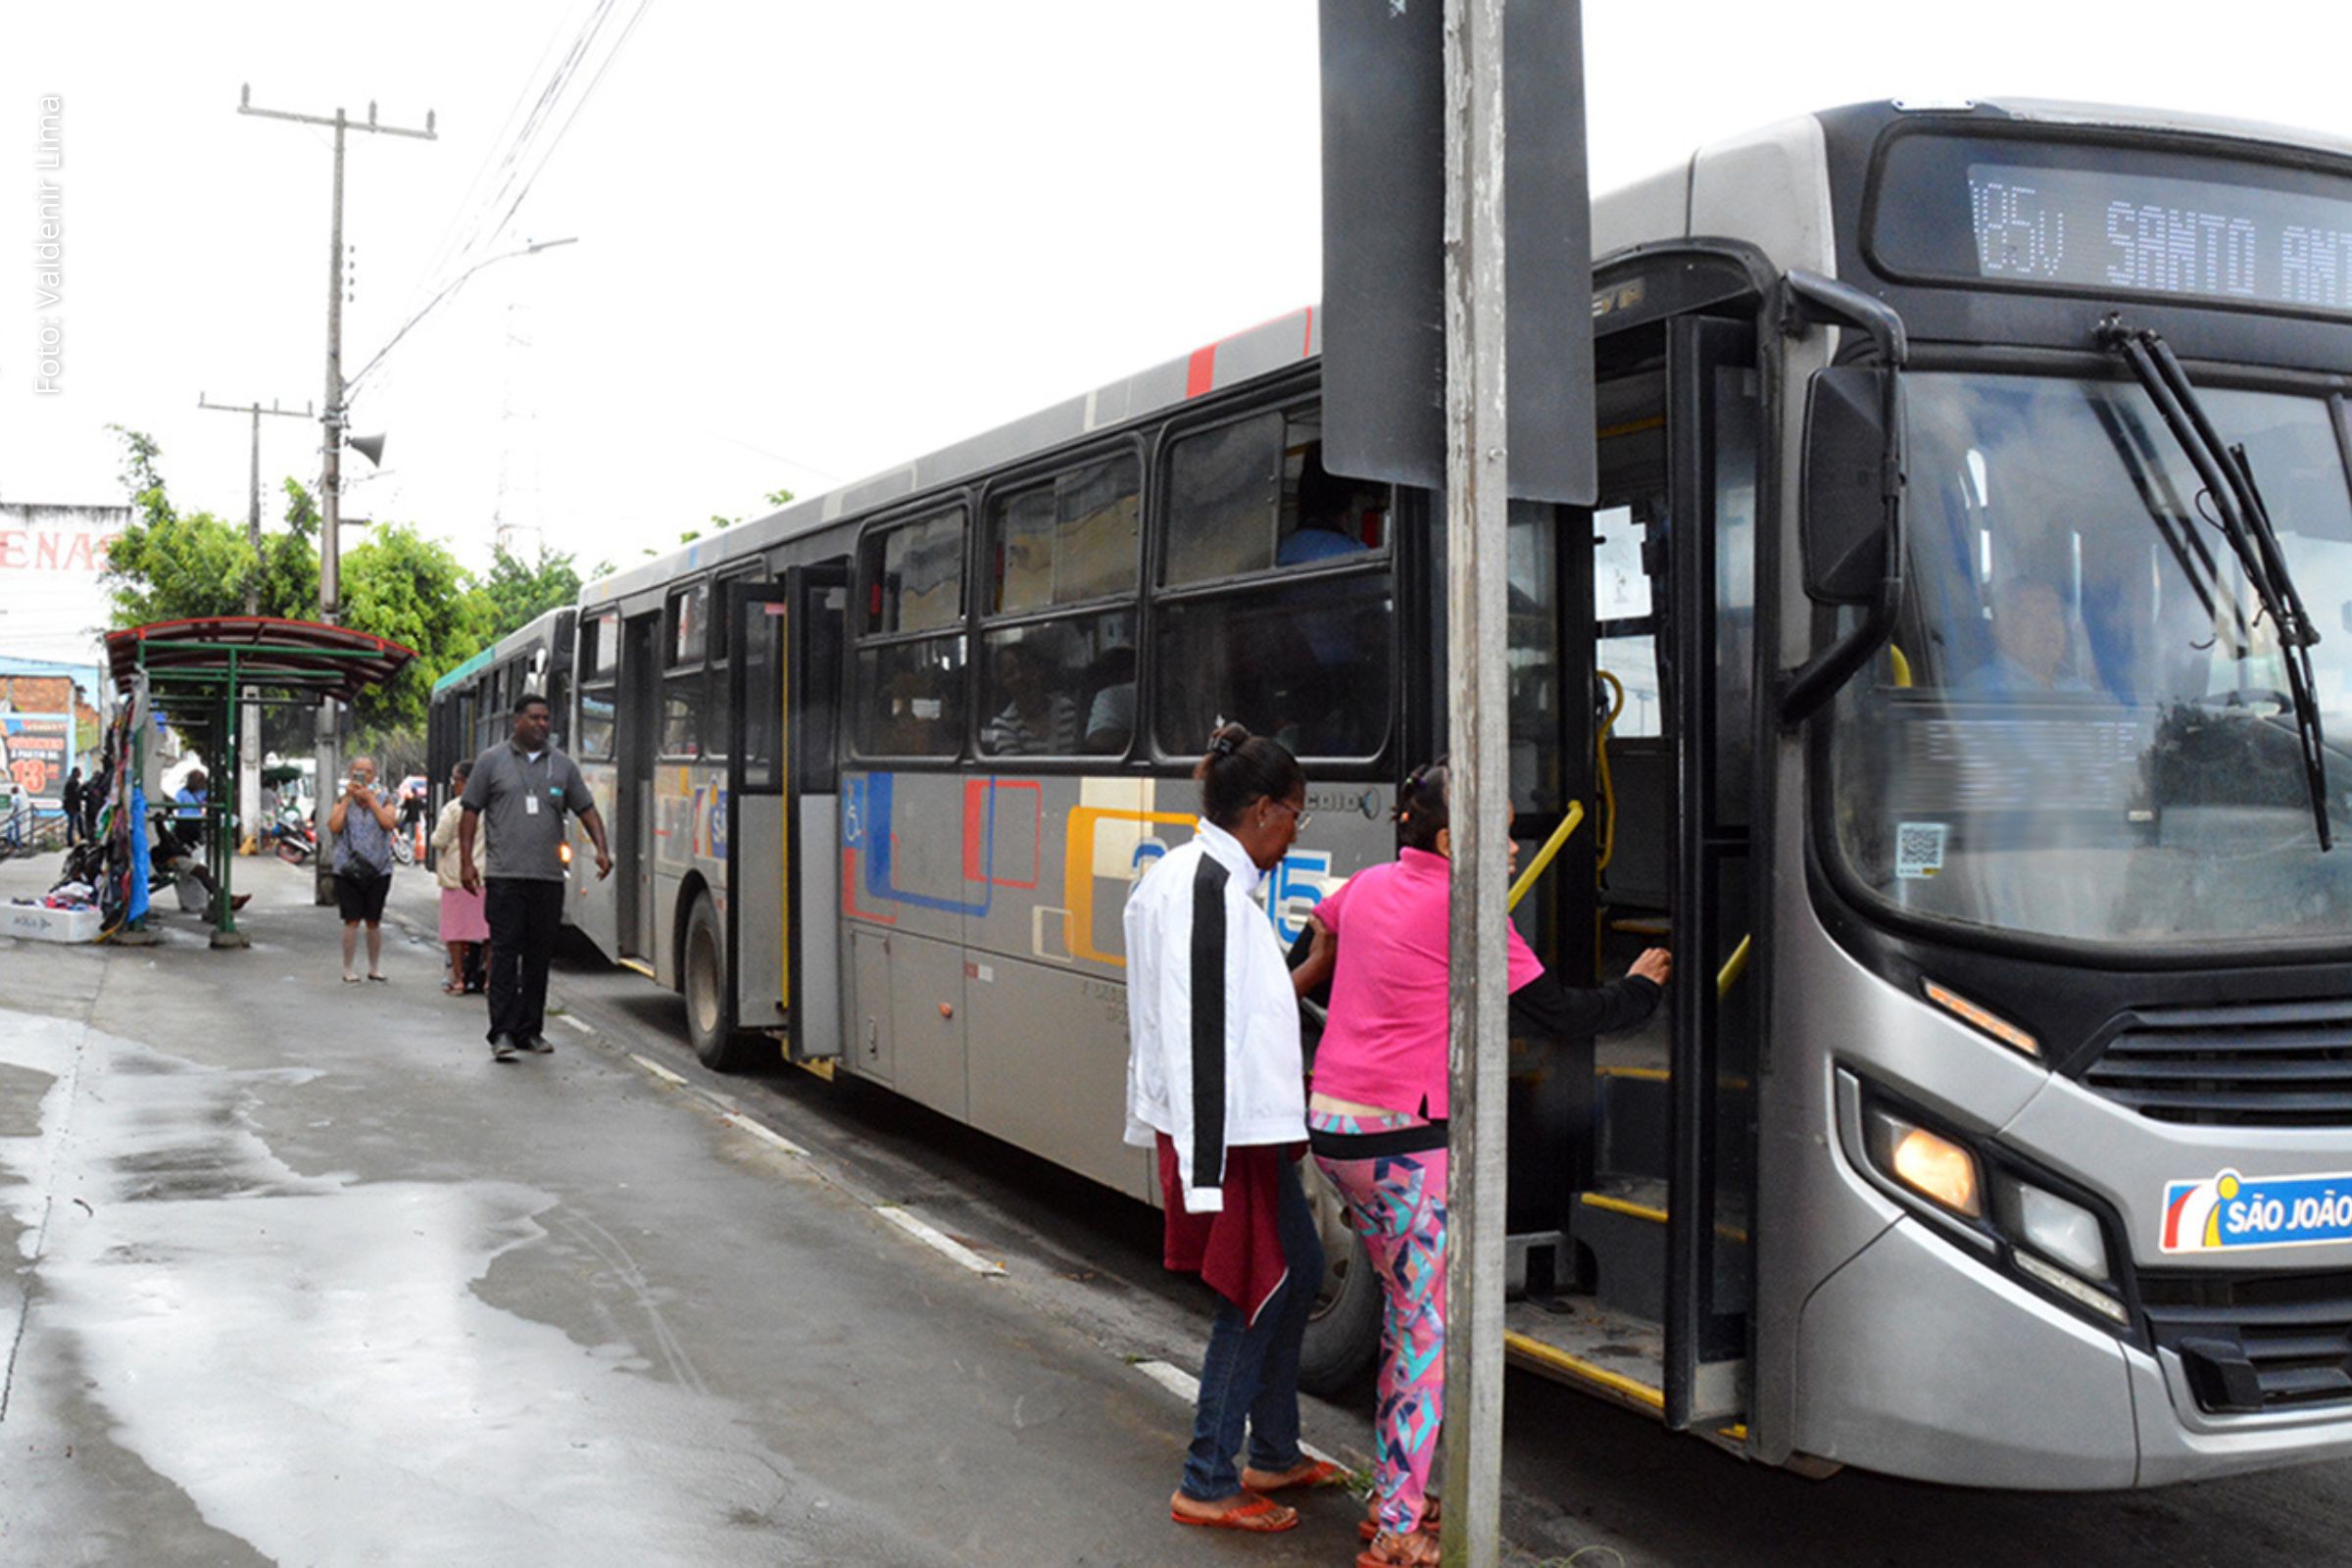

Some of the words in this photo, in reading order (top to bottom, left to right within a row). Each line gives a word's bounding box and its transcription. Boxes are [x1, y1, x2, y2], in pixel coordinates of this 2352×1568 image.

[2107, 200, 2256, 295] SANTO
[2226, 1192, 2284, 1234] SÃO
[2284, 1189, 2352, 1231] JOÃO
